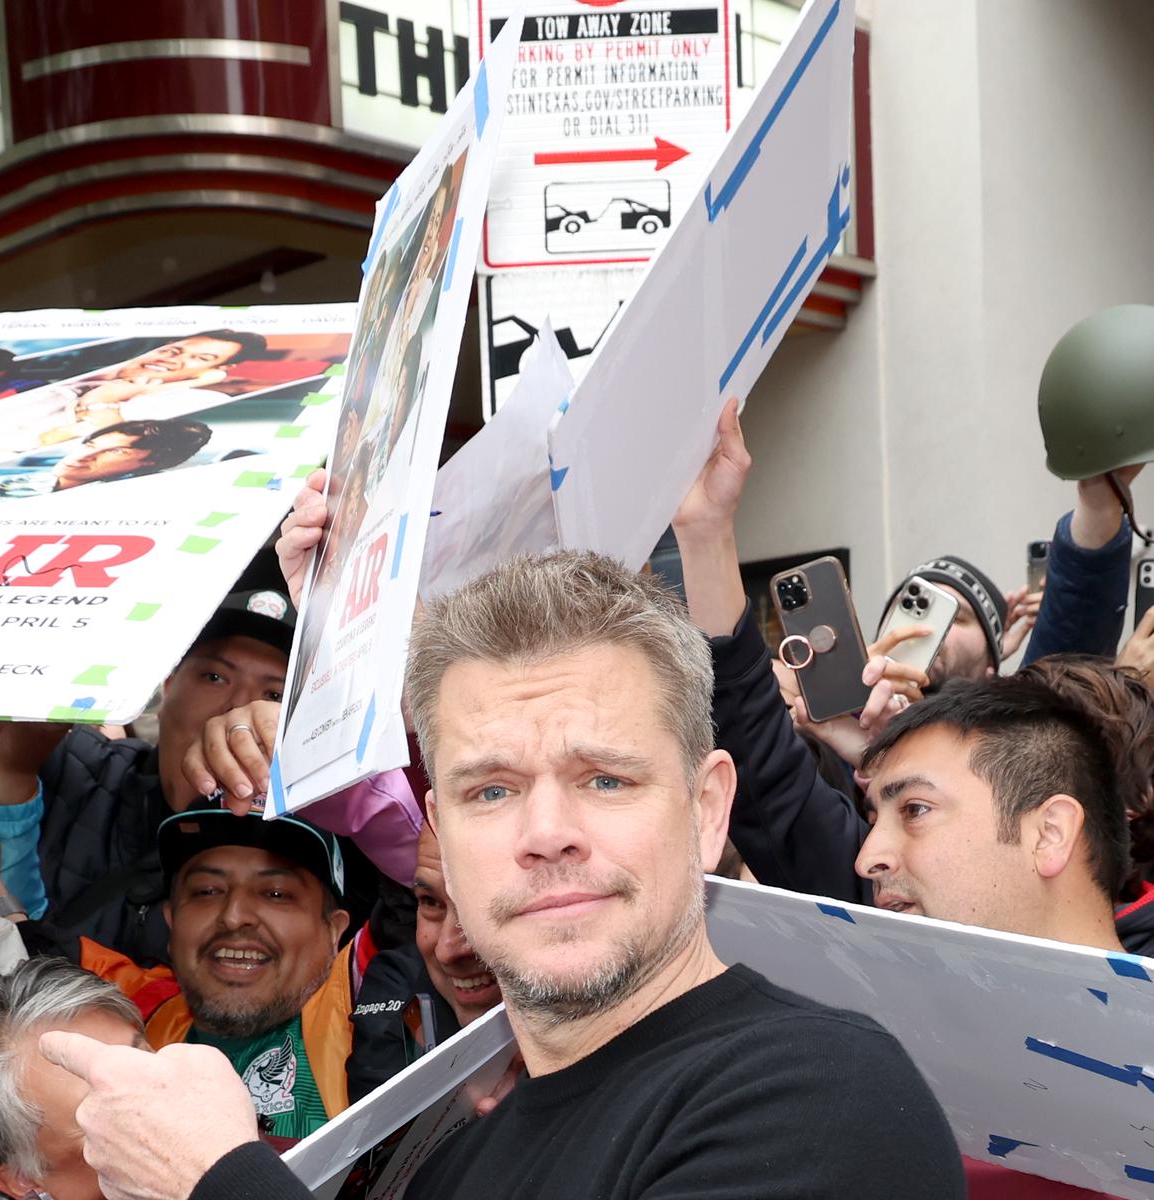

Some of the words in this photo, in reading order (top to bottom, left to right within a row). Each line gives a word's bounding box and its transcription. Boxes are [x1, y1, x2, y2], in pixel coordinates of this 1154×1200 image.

[535, 16, 569, 40] TOW
[576, 13, 621, 38] AWAY
[630, 11, 673, 35] ZONE
[518, 44, 564, 64] RKING
[575, 42, 594, 61] BY
[606, 39, 661, 60] PERMIT
[672, 37, 712, 58] ONLY
[512, 67, 537, 89] FOR
[546, 64, 596, 87] PERMIT
[604, 61, 699, 84] INFORMATION
[507, 85, 723, 116] STINTEXAS.GOV/STREETPARKING
[563, 118, 581, 137] OR
[590, 116, 621, 136] DIAL
[629, 114, 650, 135] 311
[17, 519, 49, 527] ARE
[53, 519, 112, 528] MEANT
[116, 519, 141, 528] TO
[143, 519, 174, 528] FLY
[338, 532, 388, 631] AIR
[72, 617, 92, 629] 5
[353, 1002, 385, 1016] Engage
